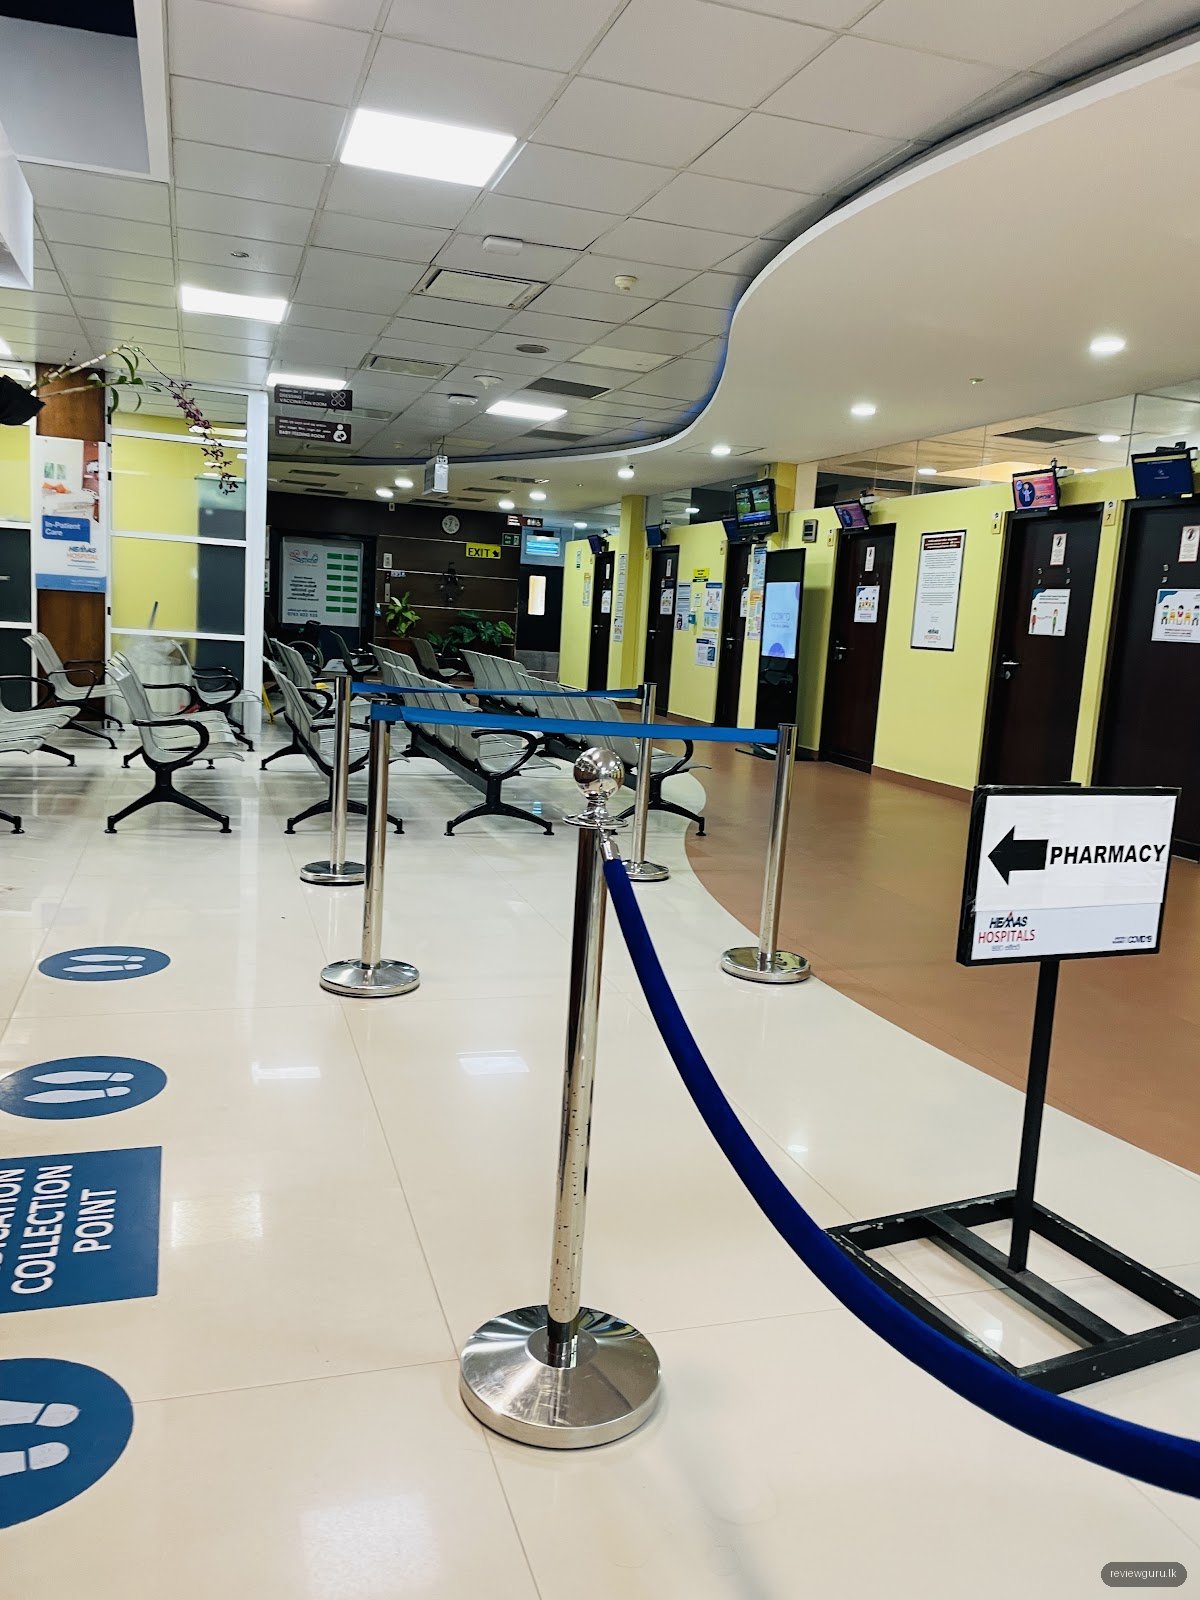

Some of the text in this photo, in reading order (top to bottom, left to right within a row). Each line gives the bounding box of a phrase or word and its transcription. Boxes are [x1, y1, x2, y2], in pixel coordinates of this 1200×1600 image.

[44, 521, 81, 530] In-Patient
[44, 528, 63, 536] Care
[468, 547, 490, 557] EXIT
[1049, 844, 1167, 865] PHARMACY
[978, 929, 1036, 944] HOSPITALS
[72, 1188, 118, 1253] POINT
[10, 1164, 74, 1295] COLLECTION
